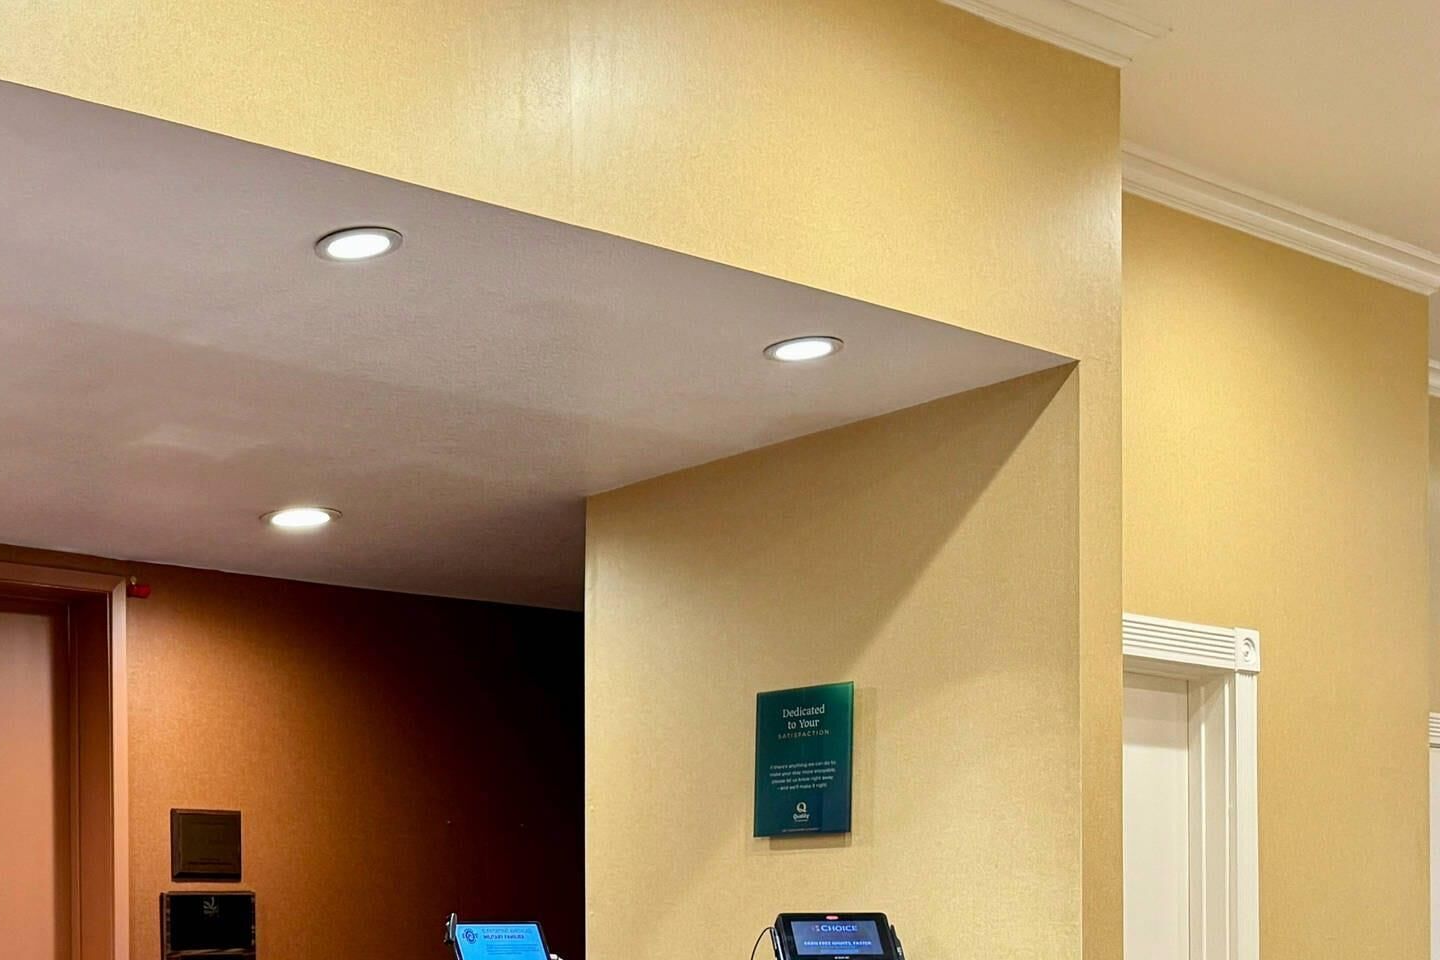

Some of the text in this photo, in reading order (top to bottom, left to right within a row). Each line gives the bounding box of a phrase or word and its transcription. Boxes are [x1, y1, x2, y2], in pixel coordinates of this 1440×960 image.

[782, 704, 825, 718] Dedicated
[787, 719, 820, 730] to Your
[778, 729, 830, 740] SATISFACTION
[820, 924, 858, 932] CHOICE
